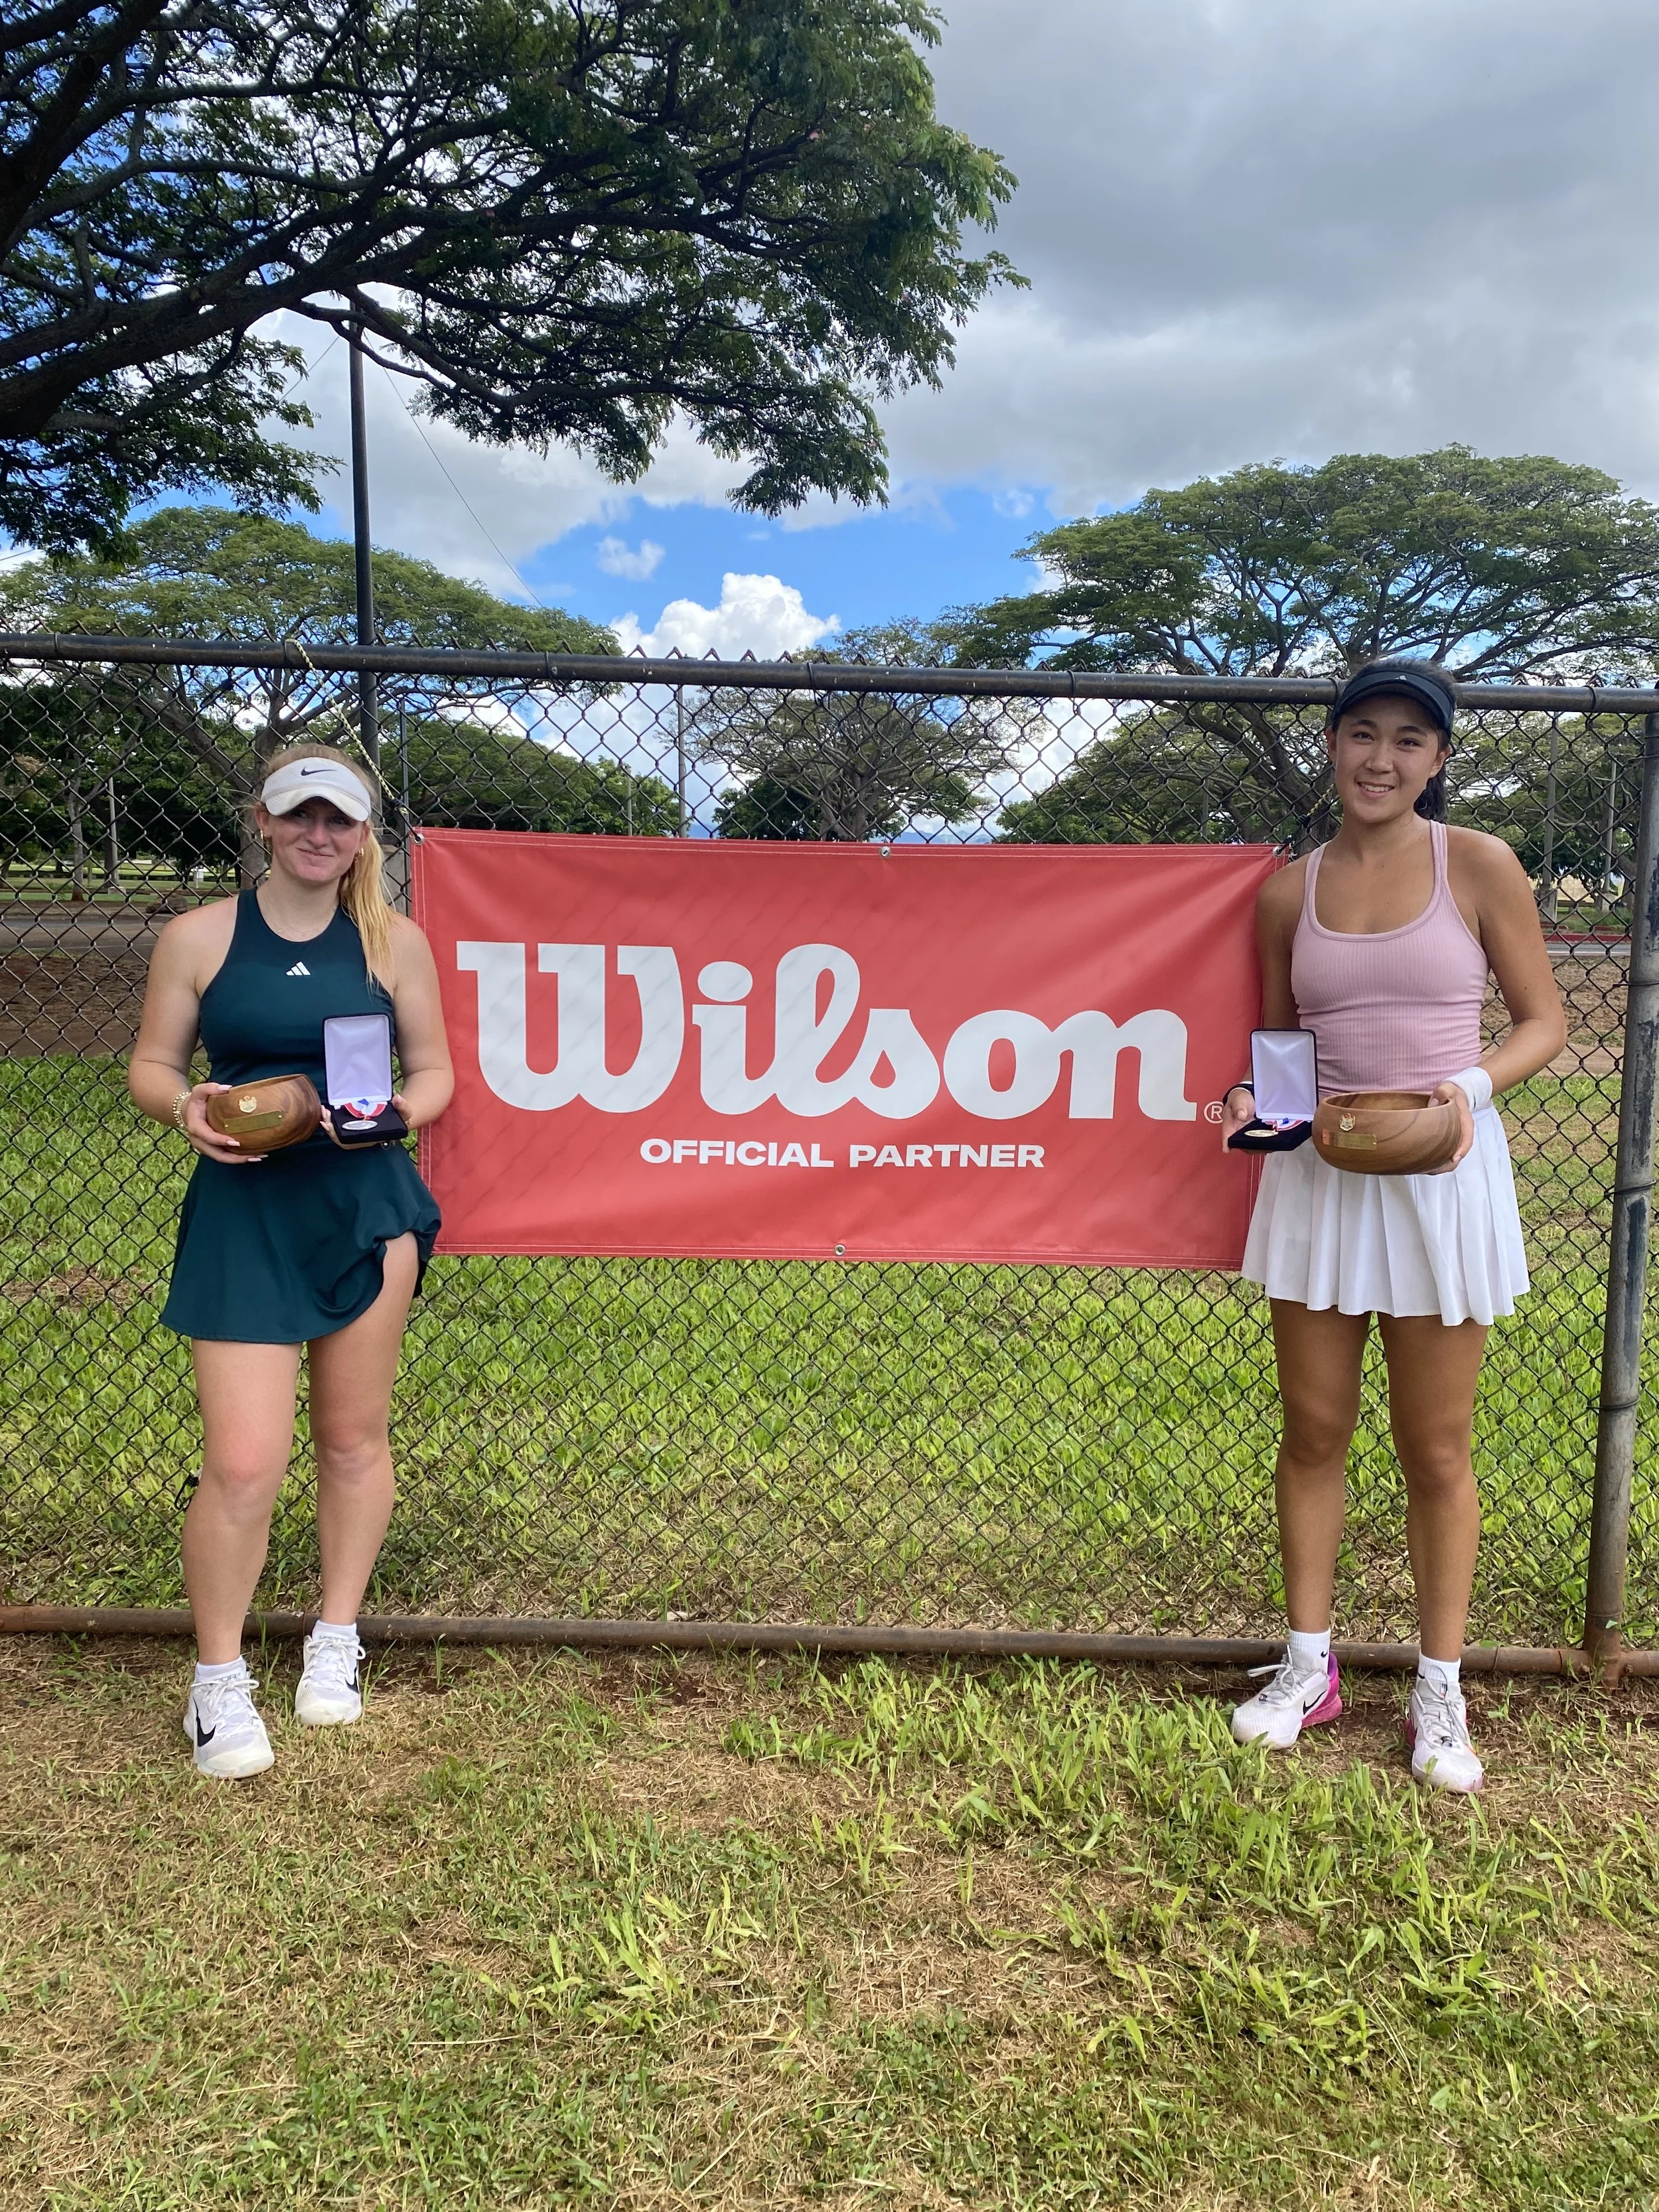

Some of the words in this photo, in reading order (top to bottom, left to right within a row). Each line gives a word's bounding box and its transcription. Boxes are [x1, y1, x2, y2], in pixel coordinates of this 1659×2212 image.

[456, 940, 1197, 1122] Wilson
[640, 1138, 834, 1168] OFFICIAL
[849, 1144, 1045, 1168] PARTNER
